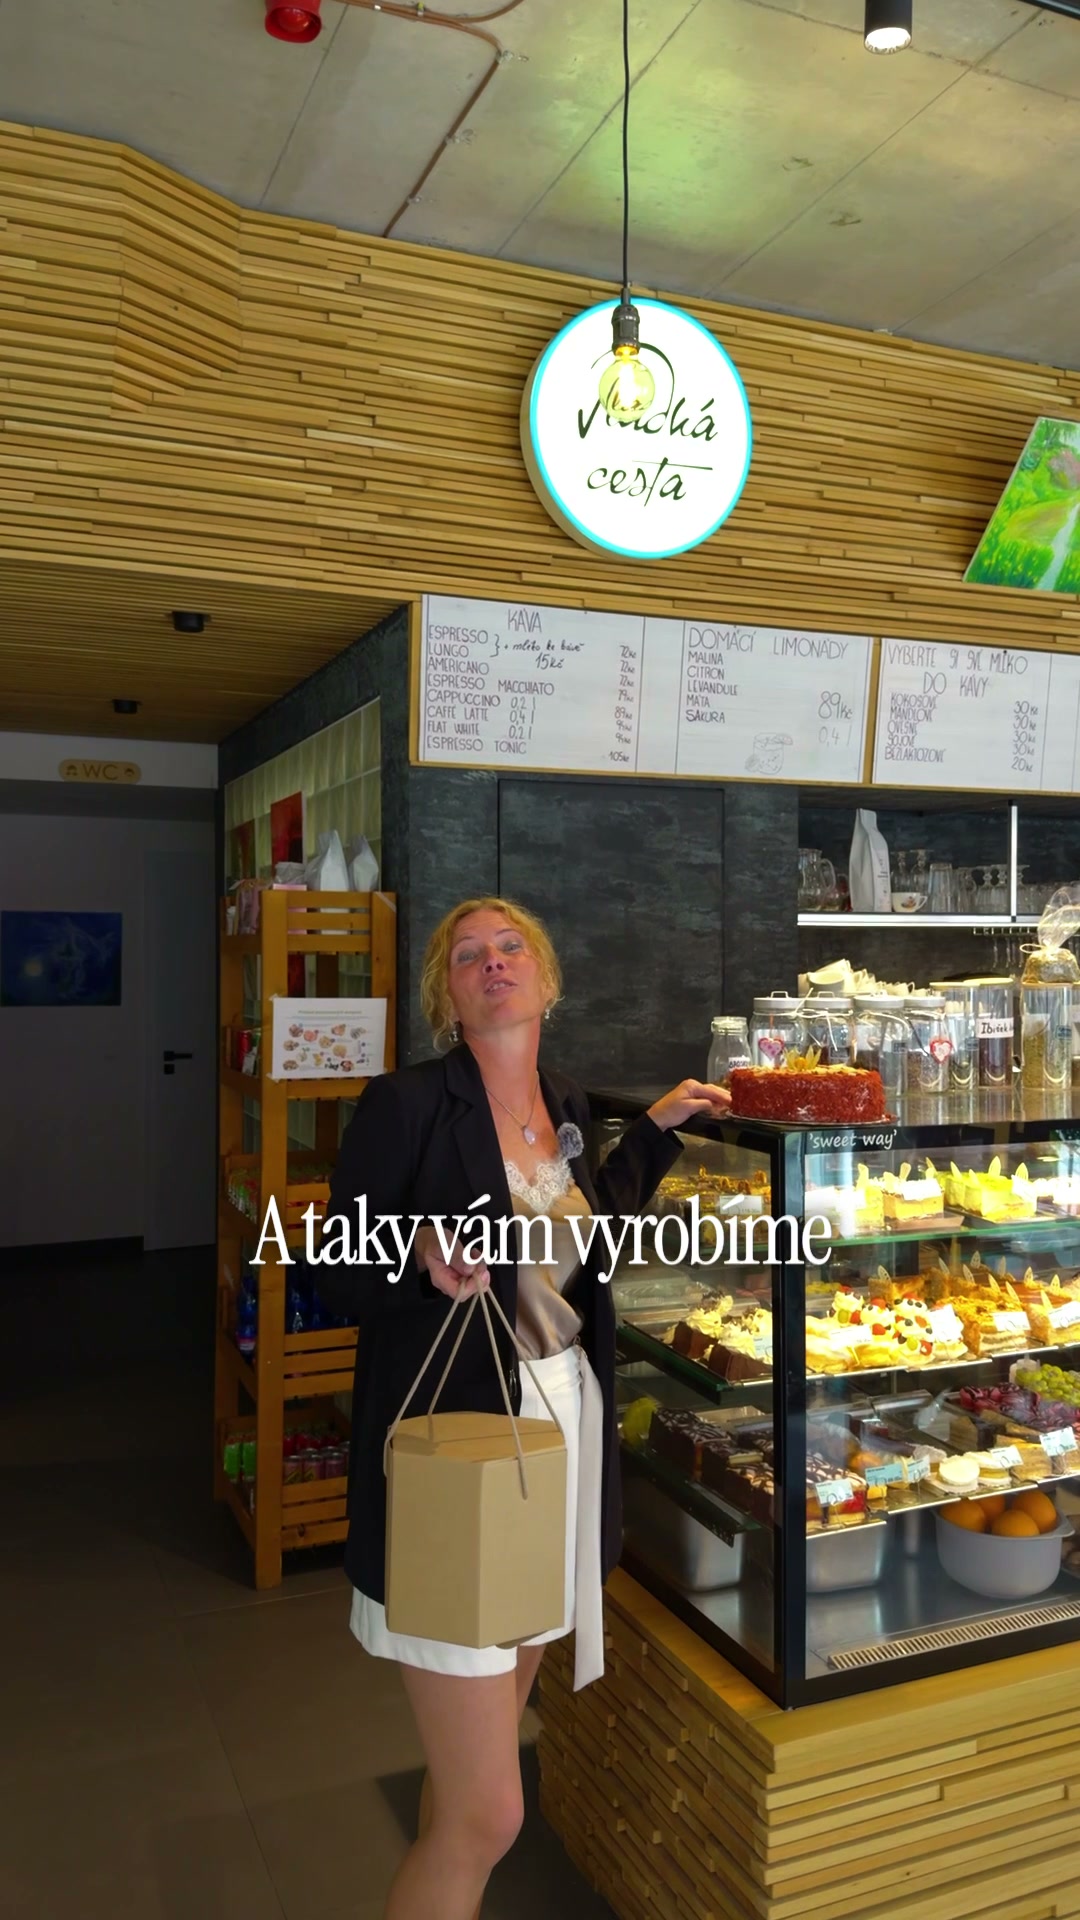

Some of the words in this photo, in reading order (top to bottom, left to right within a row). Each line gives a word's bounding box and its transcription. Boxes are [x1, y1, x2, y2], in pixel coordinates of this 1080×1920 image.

[587, 457, 713, 507] cesta
[428, 625, 488, 644] ESPRESSO
[688, 626, 757, 652] DOMÁCÍ
[772, 636, 849, 660] LIMONÁDY
[427, 642, 469, 658] LUNGO
[687, 651, 724, 665] MALINA
[887, 644, 937, 668] VYBERTE
[427, 656, 490, 675] AMERICANO
[686, 665, 725, 680] CITRON
[427, 673, 485, 690] ESPRESSO
[498, 680, 555, 696] MACCHIATO
[687, 680, 738, 696] LEVANDULE
[923, 671, 947, 695] DO
[426, 688, 501, 707] CAPPUCCINO
[890, 692, 938, 709] KOKOSOVÉ
[464, 707, 488, 722] LATTE
[685, 709, 725, 724] SAKURA
[427, 721, 447, 734] FLAT
[454, 723, 480, 736] WHITE
[426, 736, 484, 752] ESPRESSO
[495, 740, 527, 755] TONIC
[82, 763, 119, 780] WC
